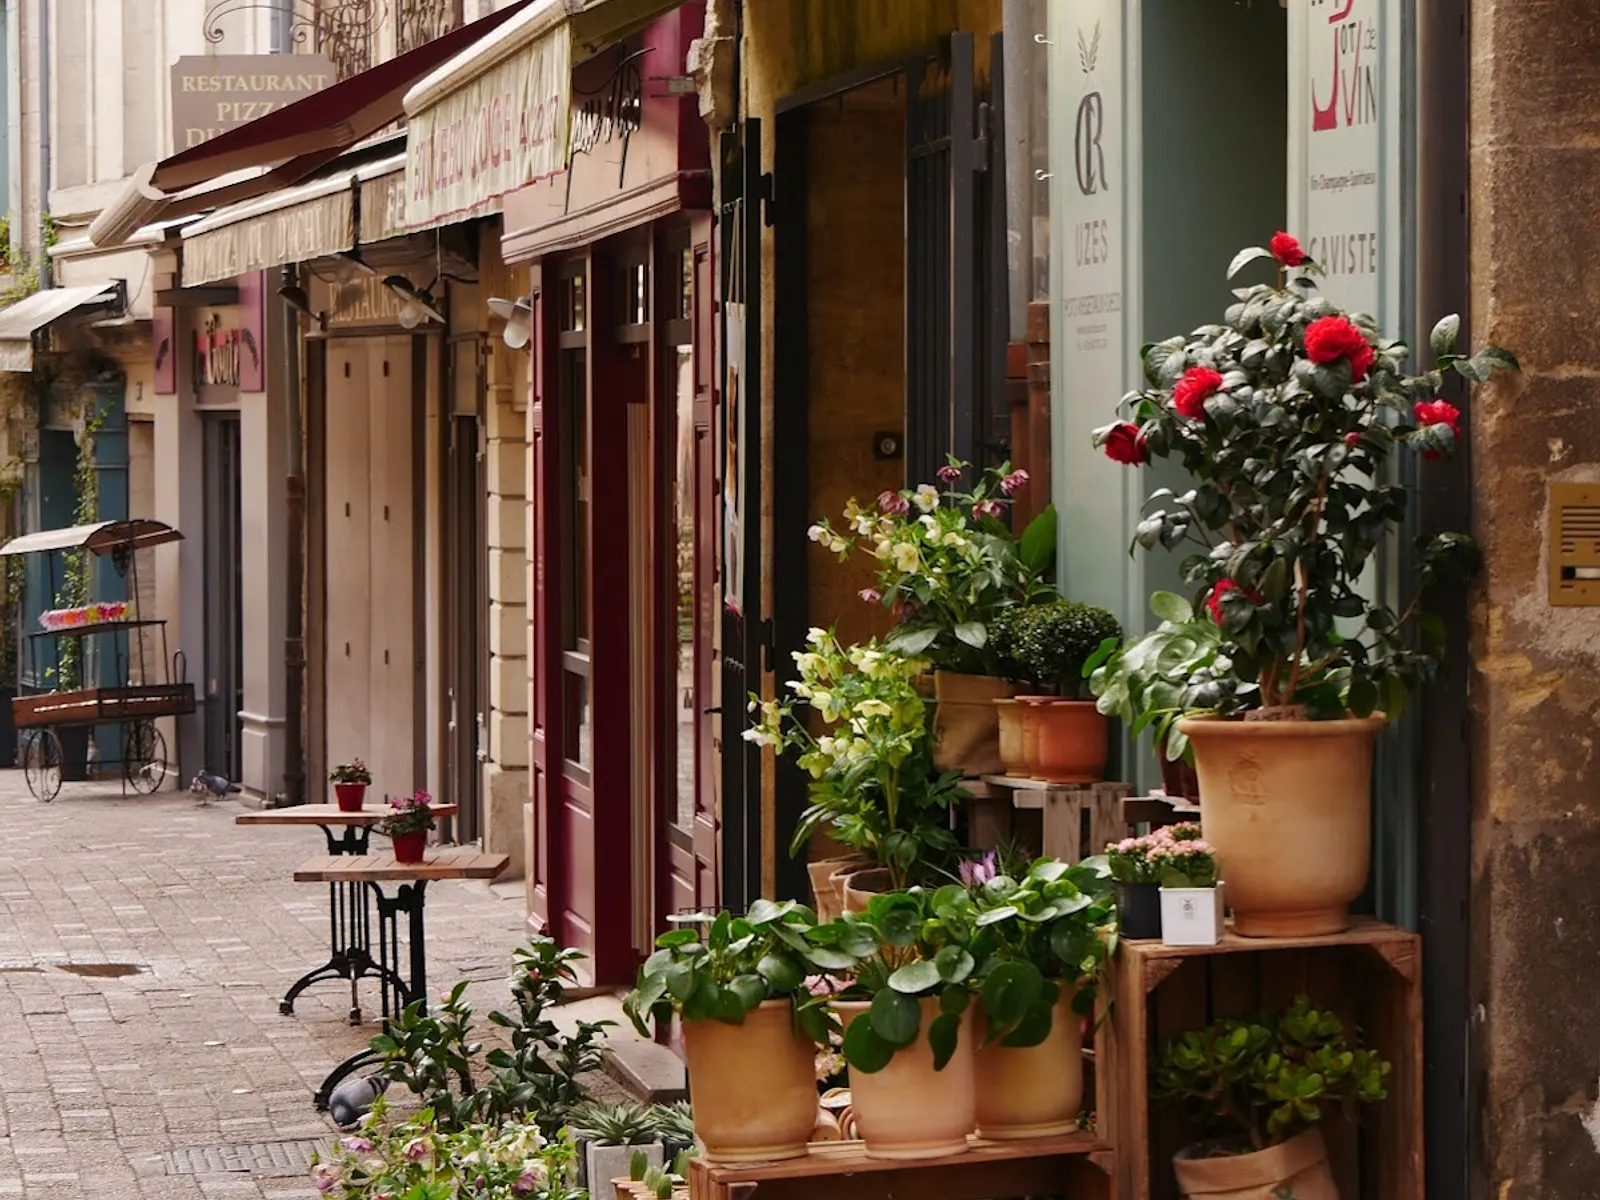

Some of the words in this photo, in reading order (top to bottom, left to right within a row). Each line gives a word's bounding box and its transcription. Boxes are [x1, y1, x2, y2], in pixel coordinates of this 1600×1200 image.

[182, 75, 328, 92] RESTAURANT
[1341, 20, 1376, 127] VIN
[217, 101, 289, 121] PIZZ
